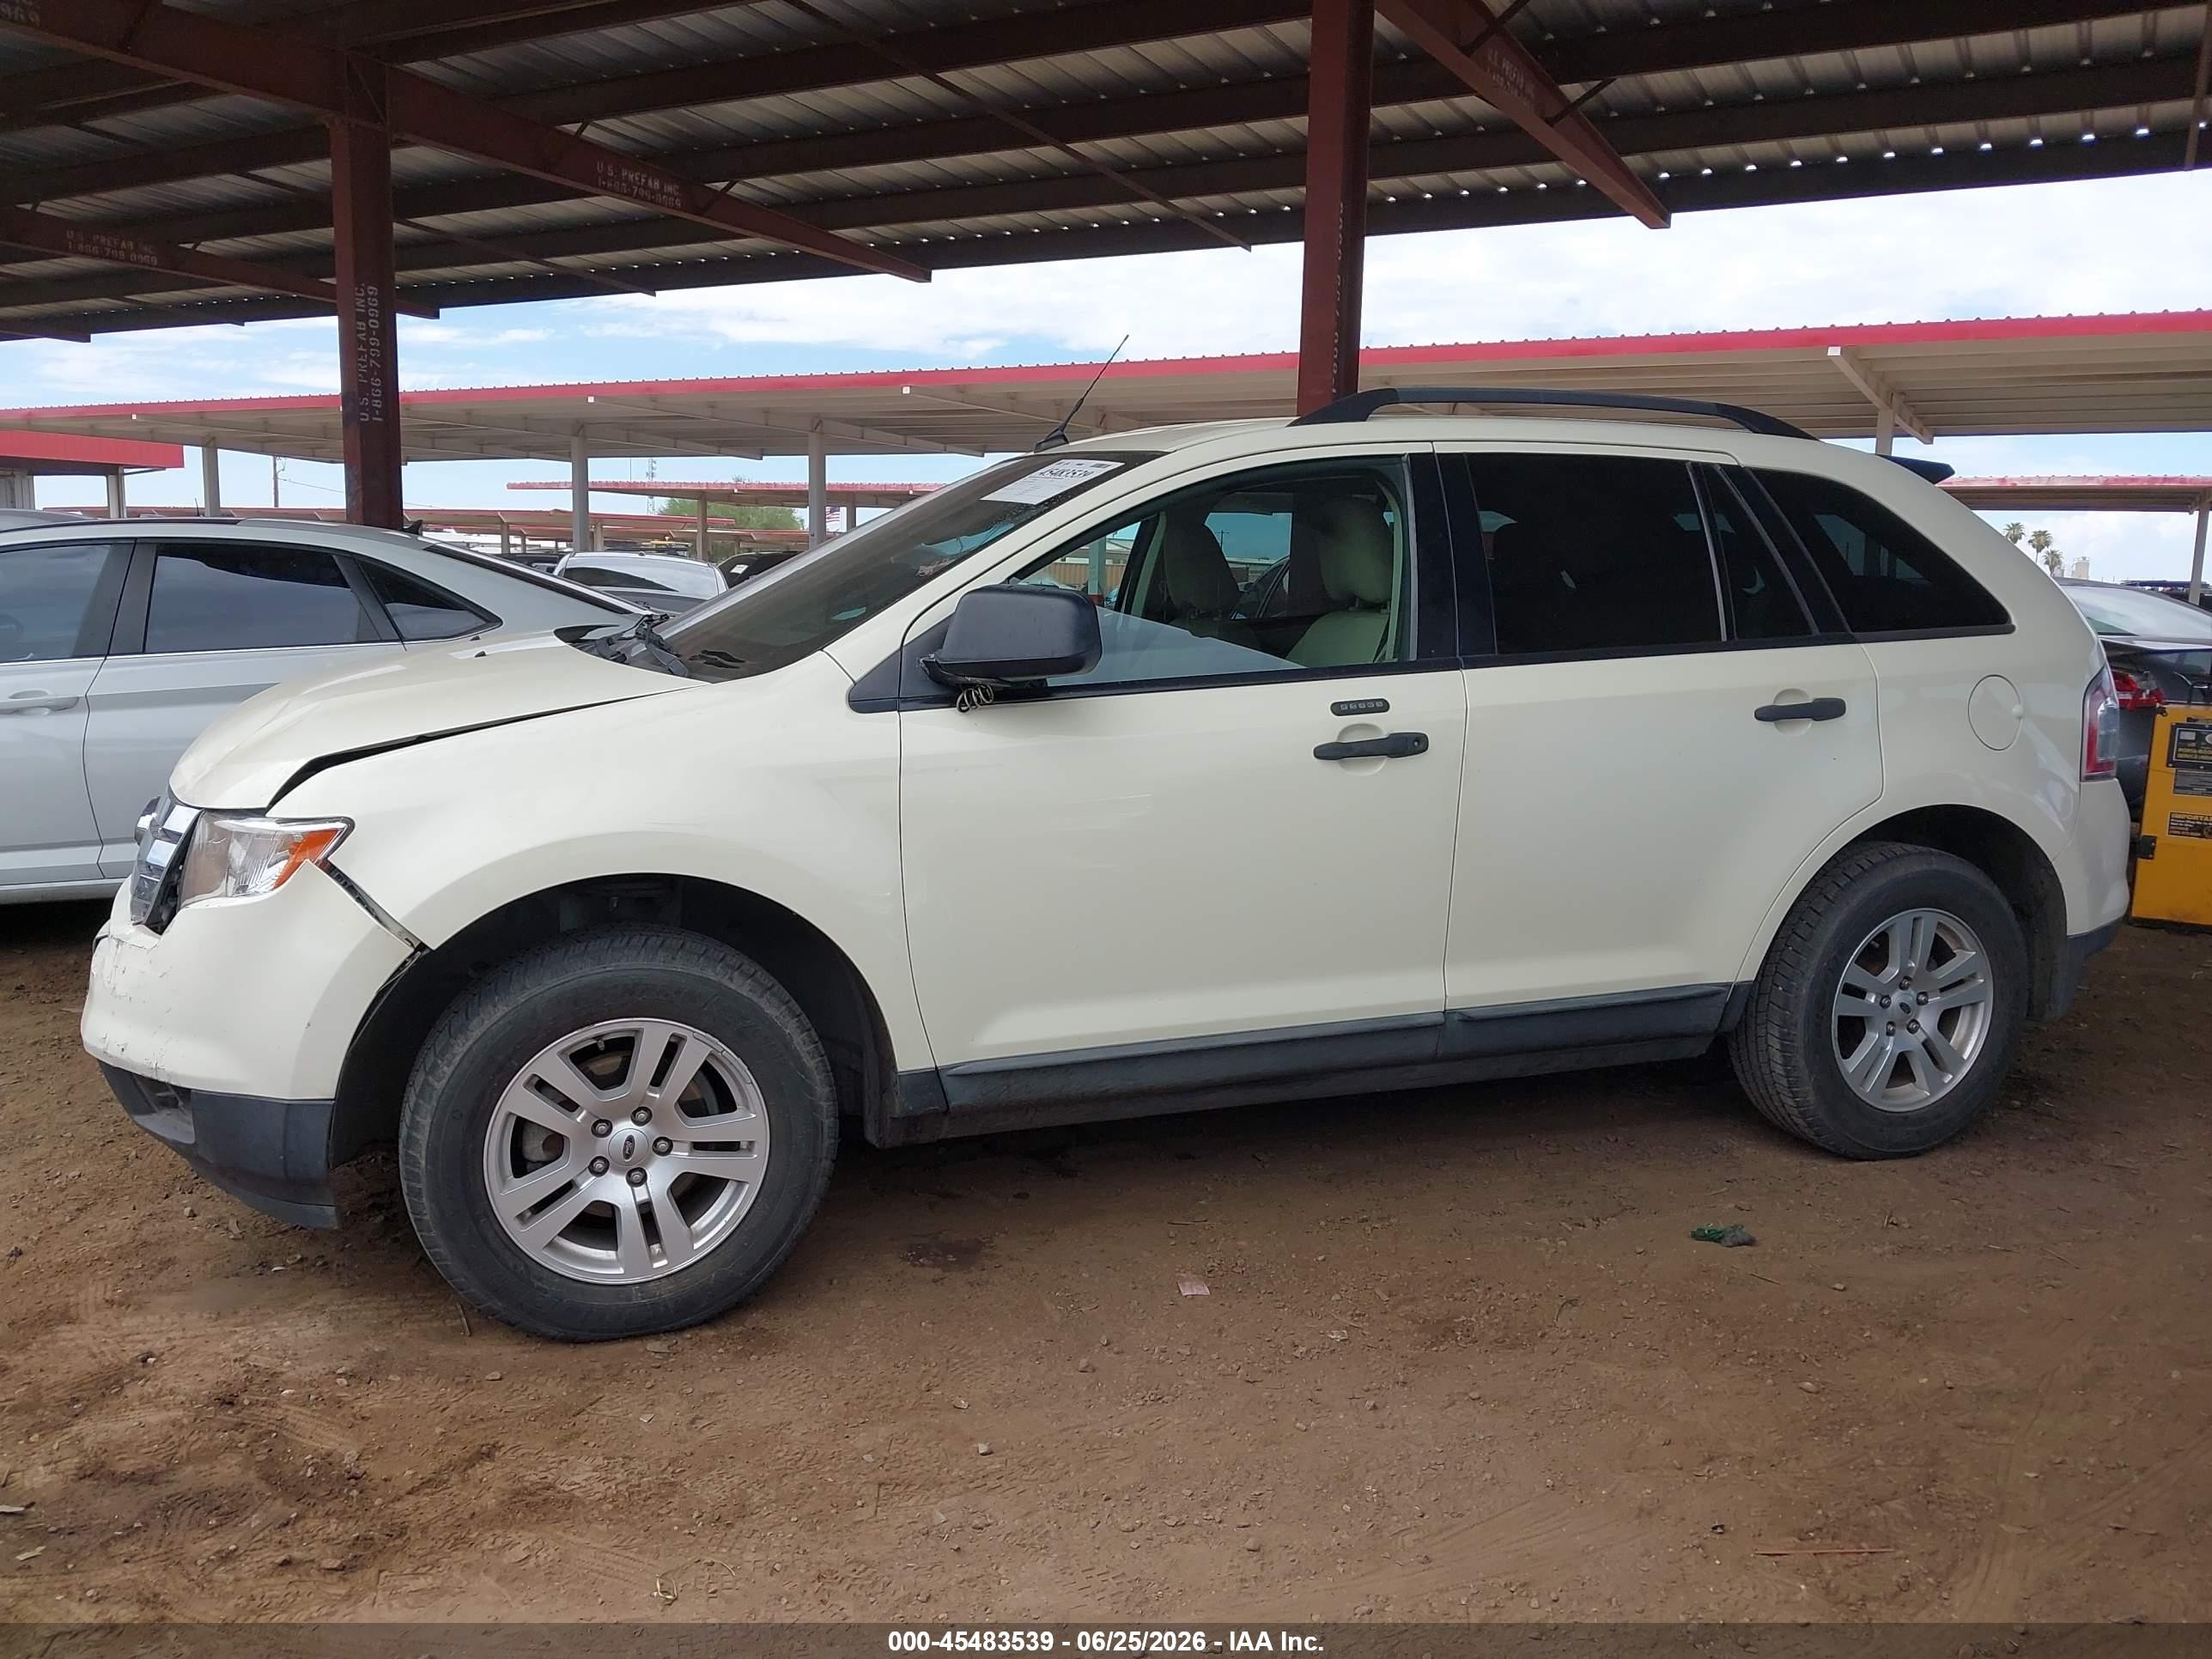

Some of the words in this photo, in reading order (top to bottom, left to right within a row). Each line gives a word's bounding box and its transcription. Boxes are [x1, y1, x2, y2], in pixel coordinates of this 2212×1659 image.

[355, 283, 366, 313] INC.
[356, 322, 368, 383] PREFAB
[367, 285, 383, 422] 1-866-799-0969
[359, 392, 370, 422] U.S.
